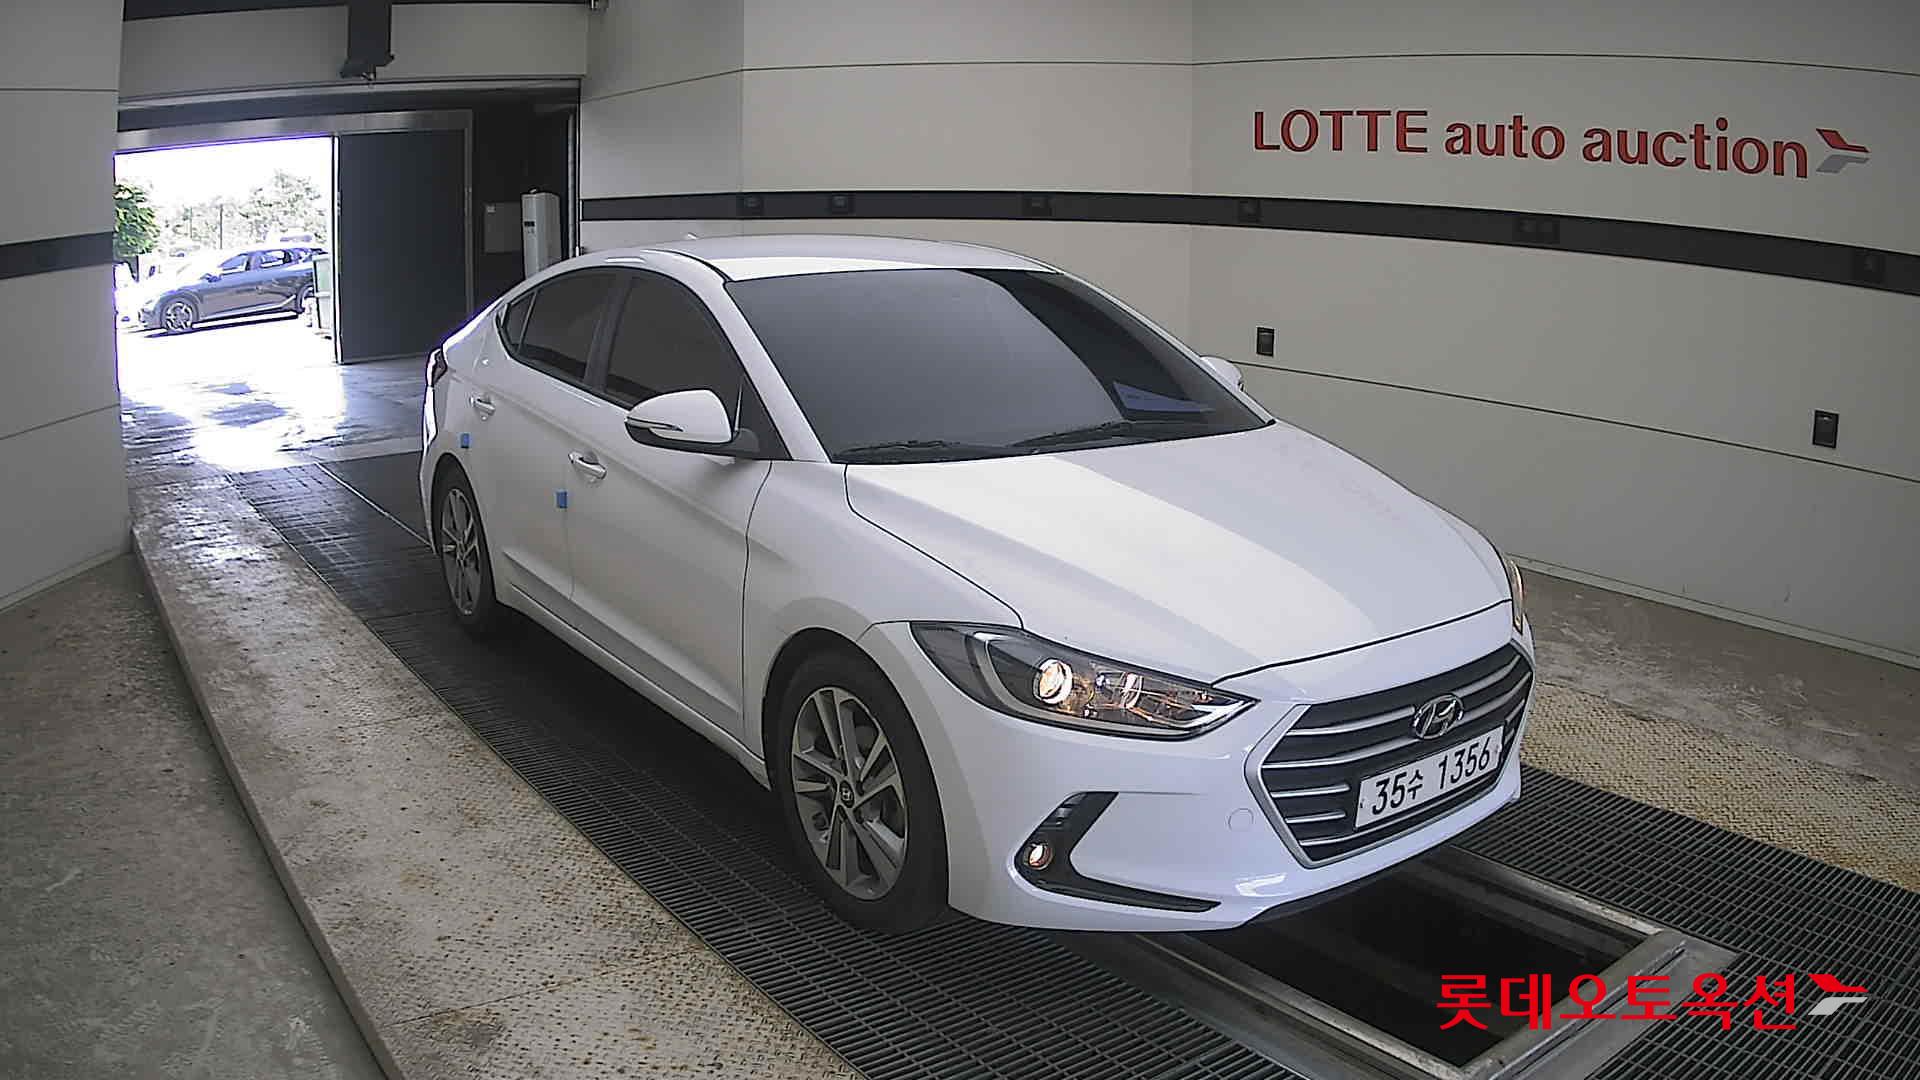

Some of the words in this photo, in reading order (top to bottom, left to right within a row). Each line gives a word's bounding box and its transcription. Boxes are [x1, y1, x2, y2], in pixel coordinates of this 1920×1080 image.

[1254, 110, 1428, 153] LOTTE
[1445, 115, 1565, 159] auto
[1582, 117, 1808, 178] auction
[1371, 769, 1423, 815] 35수
[1438, 736, 1491, 790] 1356
